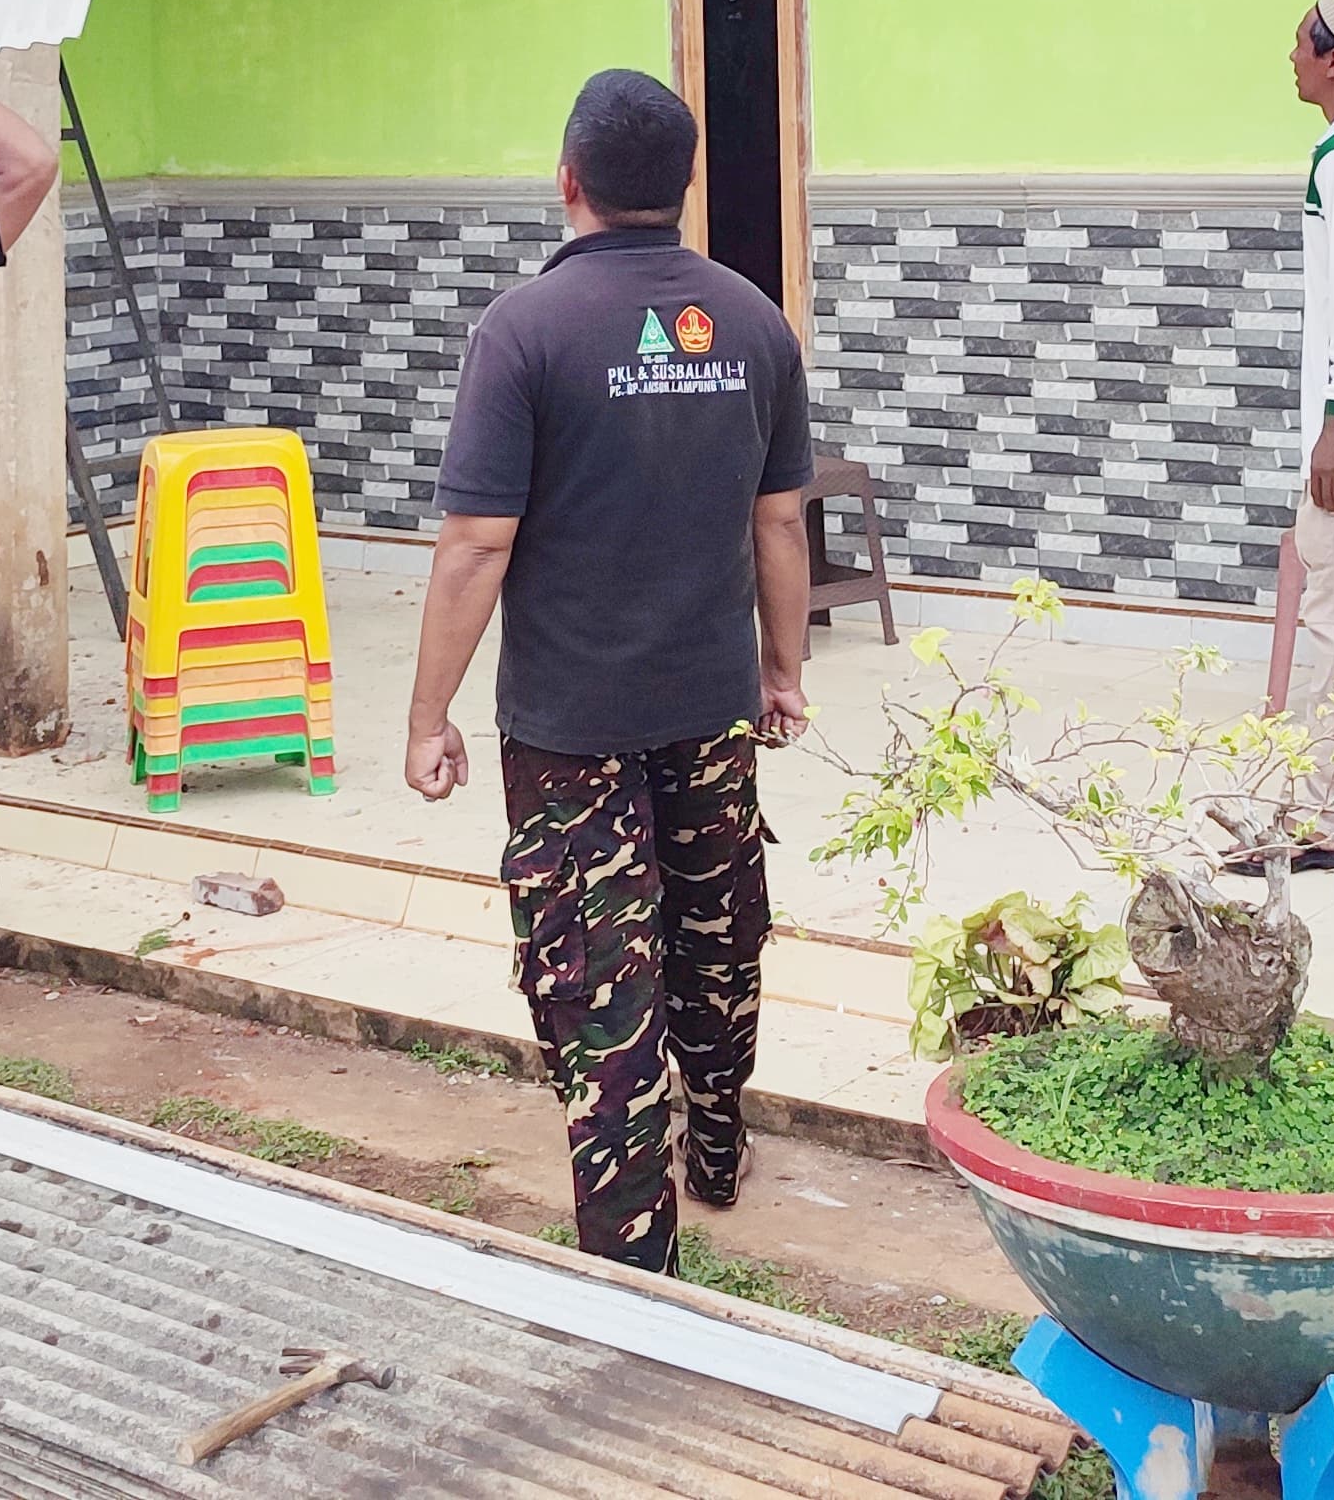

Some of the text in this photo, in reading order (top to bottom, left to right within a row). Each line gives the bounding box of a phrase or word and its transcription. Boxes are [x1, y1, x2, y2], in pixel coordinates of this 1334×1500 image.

[608, 361, 746, 384] PKL & SUSBALAN I-V
[671, 380, 718, 394] LAMPUNG
